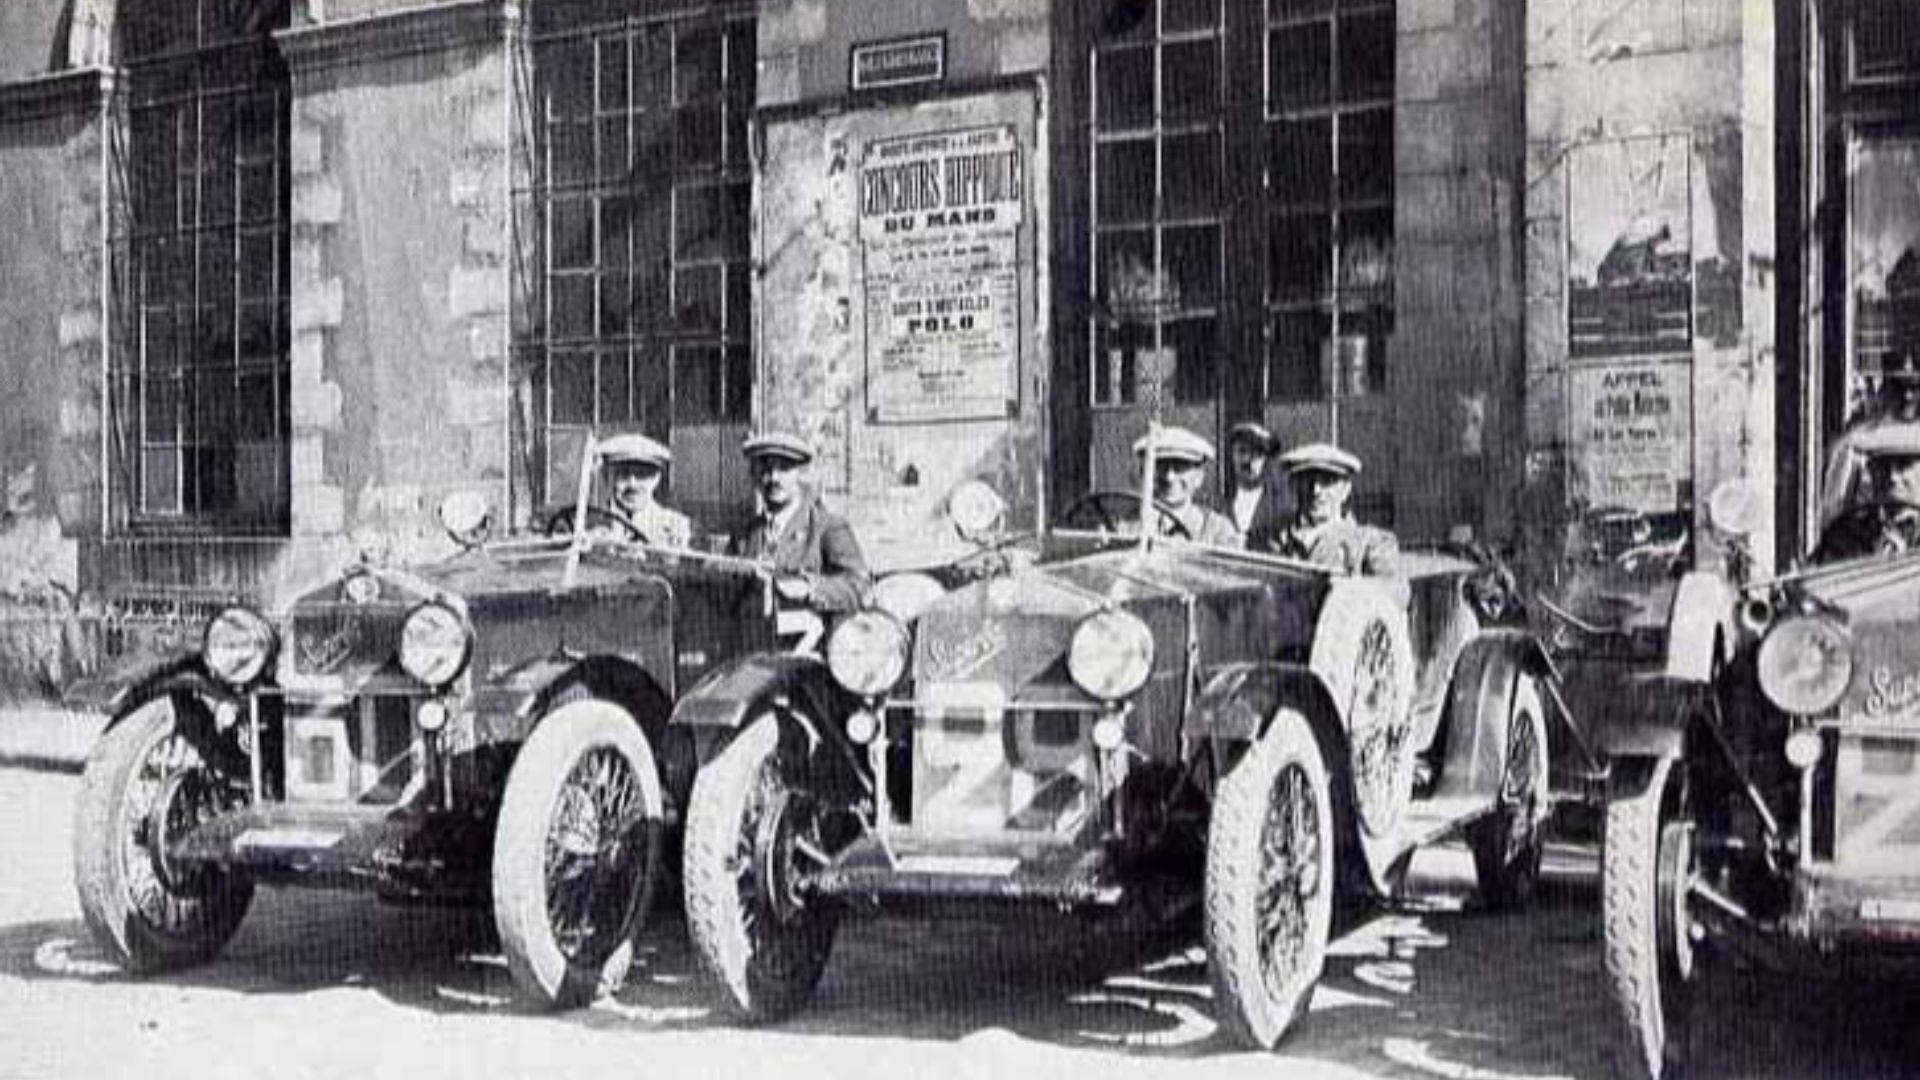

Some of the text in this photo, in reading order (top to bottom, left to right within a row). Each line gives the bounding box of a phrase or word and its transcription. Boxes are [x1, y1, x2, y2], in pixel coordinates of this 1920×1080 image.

[862, 157, 942, 220] CONCOURS
[884, 215, 915, 234] DU
[908, 314, 974, 336] POLO
